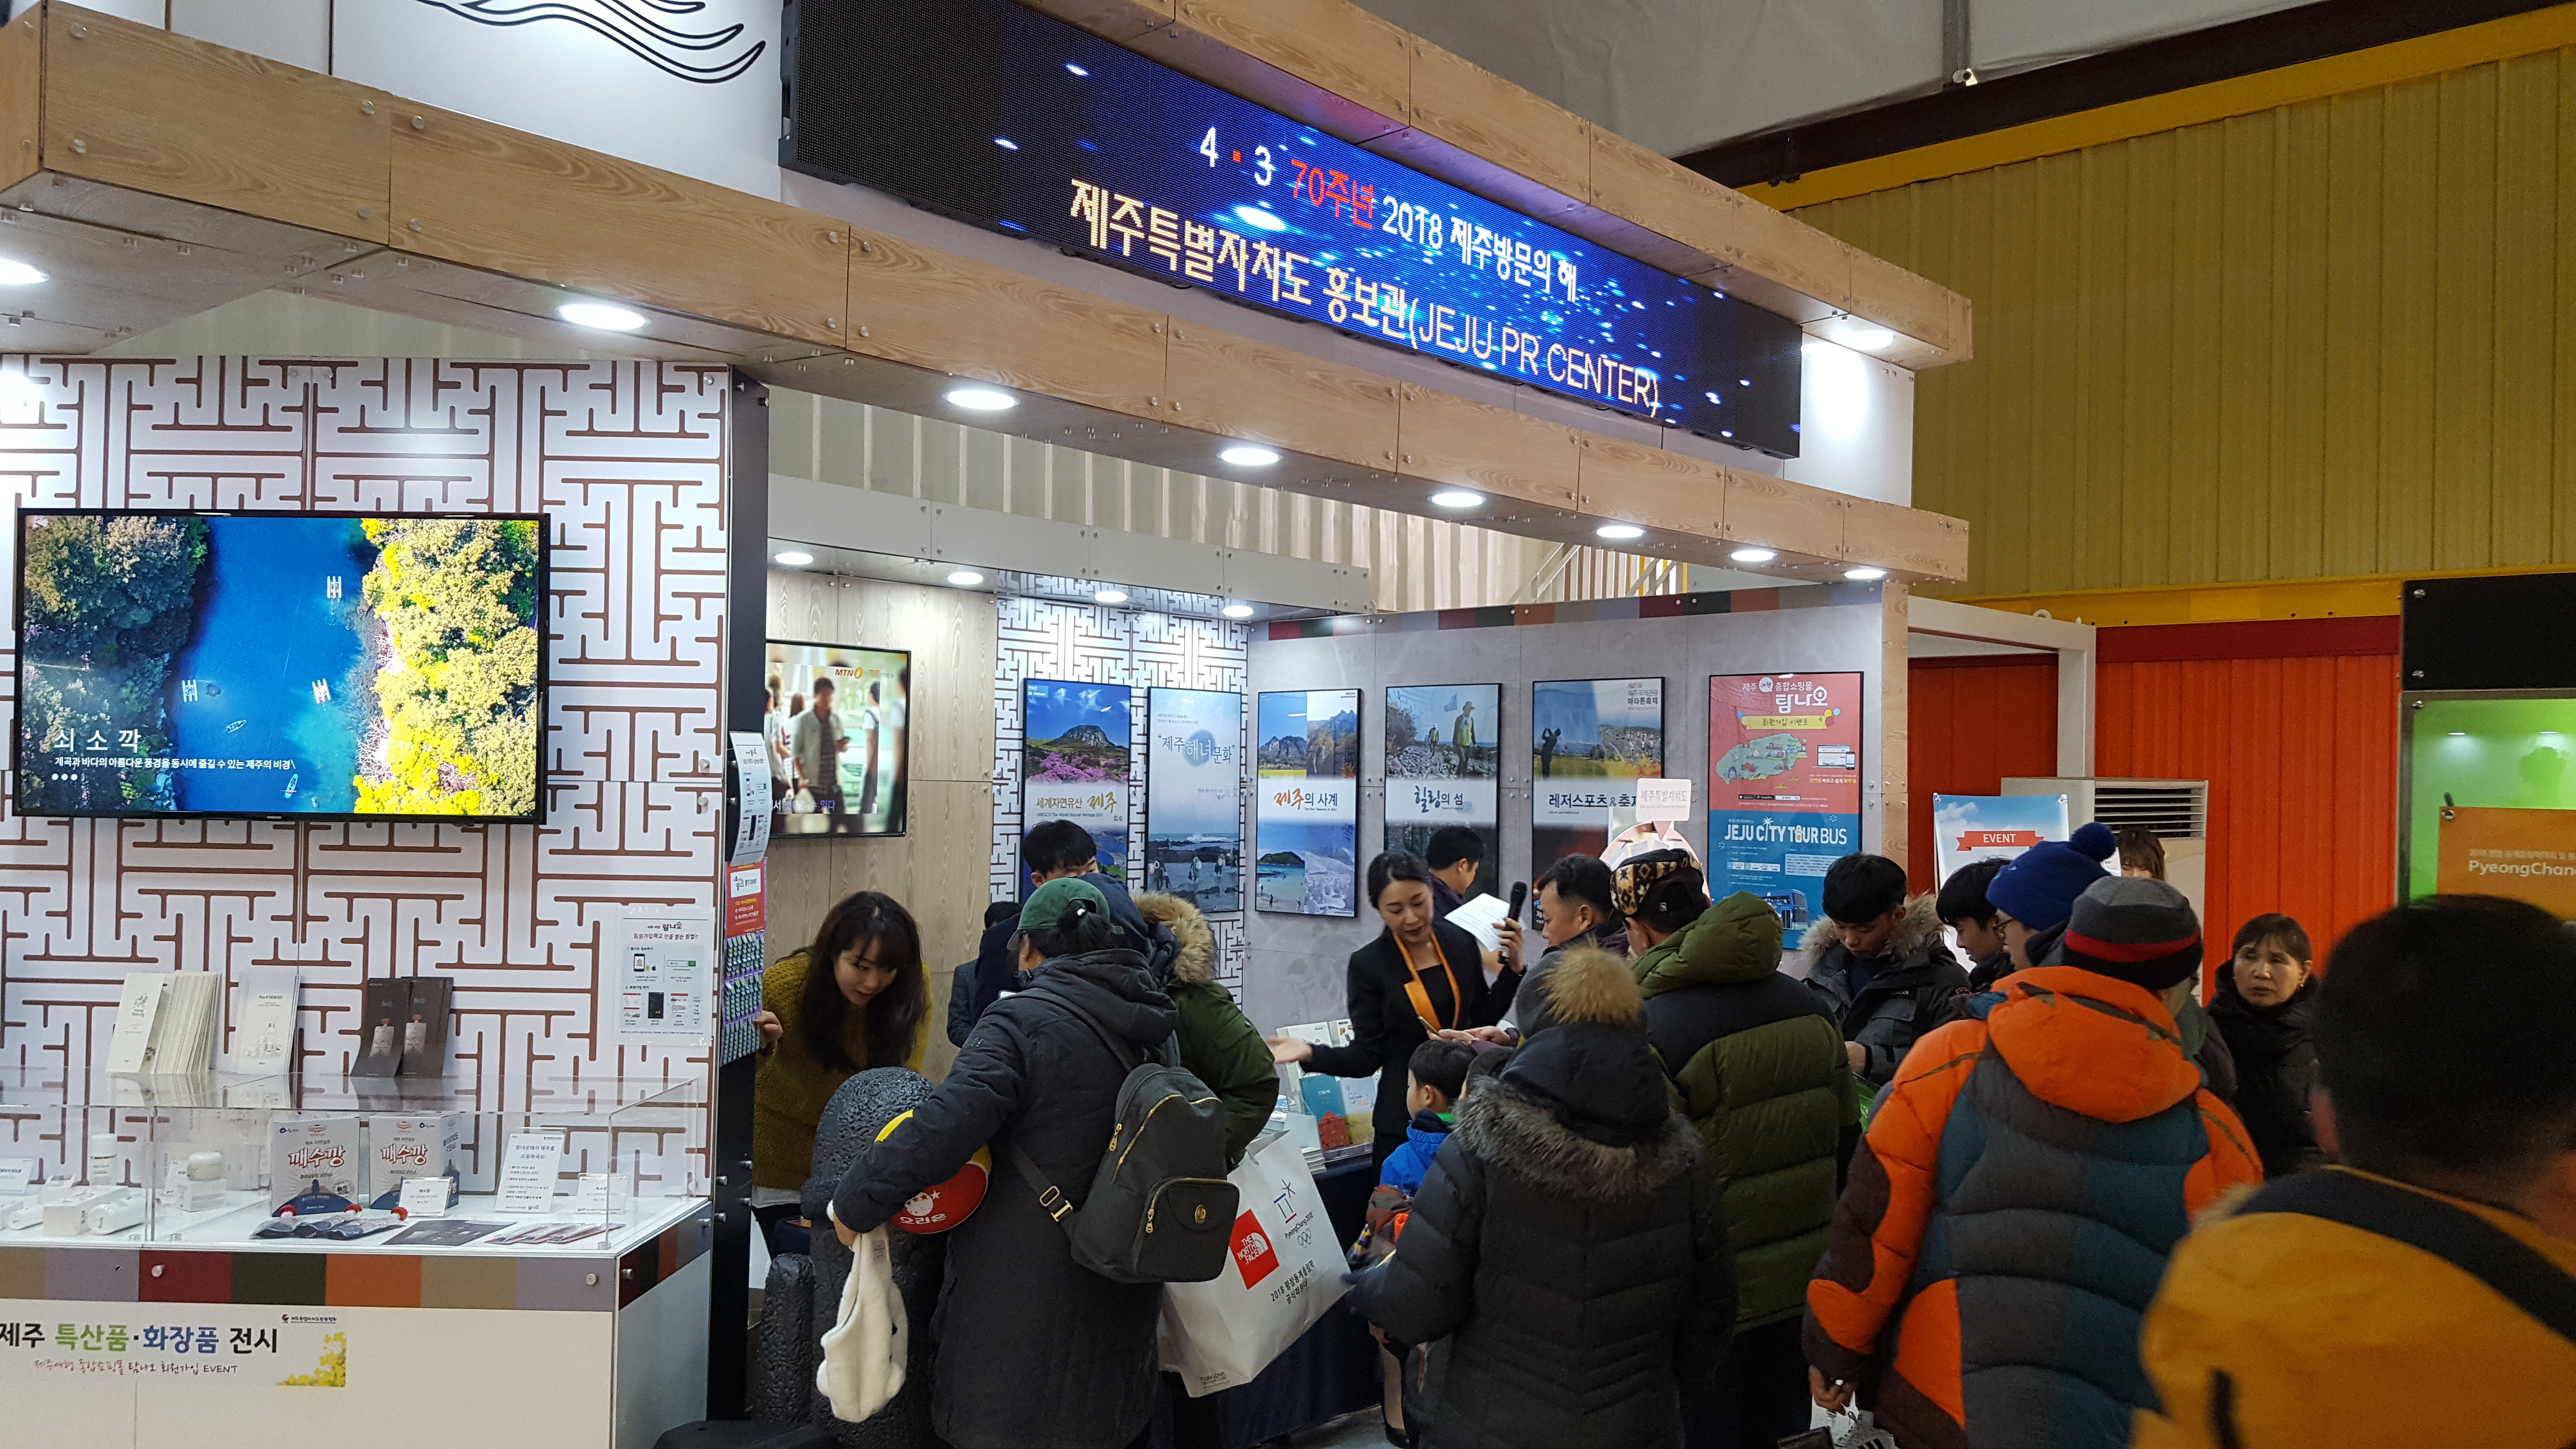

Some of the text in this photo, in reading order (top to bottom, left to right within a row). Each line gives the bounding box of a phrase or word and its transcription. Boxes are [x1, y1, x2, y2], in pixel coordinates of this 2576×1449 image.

[1291, 159, 1373, 229] 70주년
[1383, 196, 1443, 250] 2018
[1450, 216, 1551, 293] 제주방문의
[1557, 259, 1577, 303] 해
[1070, 178, 1312, 305] 제주특별자치도
[1502, 327, 1539, 375] PR
[1546, 343, 1659, 418] CENTER)
[835, 669, 854, 677] MTN
[1742, 682, 1757, 692] 제주
[1186, 739, 1211, 760] 해녀
[55, 757, 81, 767] 계곡과
[81, 757, 107, 768] 바다의
[109, 757, 143, 768] 아름다운
[144, 758, 170, 769] 풍경을
[171, 758, 197, 769] 동시에
[198, 758, 216, 770] 즐길
[217, 759, 226, 770] 수
[227, 759, 244, 770] 있는
[245, 759, 272, 770] 제주의
[1036, 791, 1117, 813] 세계자연유산 제주
[1273, 788, 1338, 810] 제주의 사계
[1454, 793, 1463, 805] 섬
[1548, 793, 1609, 808] 레저스포츠
[1640, 789, 1688, 802] 제주특별자치도
[820, 800, 835, 812] 있다
[1724, 824, 1754, 841] JEJU
[1755, 817, 1787, 842] CITY
[1820, 828, 1848, 845] BUS
[1982, 833, 2016, 844] EVENT
[2468, 859, 2576, 877] PyeongChan
[899, 1213, 947, 1225] 오리온
[1240, 1234, 1253, 1247] THE
[1237, 1242, 1256, 1260] NORTH
[1245, 1248, 1262, 1265] FACE
[1271, 1286, 1285, 1302] 2018
[0, 1322, 46, 1349] 제주
[229, 1327, 278, 1354] 전시
[128, 1361, 157, 1374] 탐나오
[161, 1360, 199, 1376] 회원가입
[203, 1364, 239, 1374] EVENT
